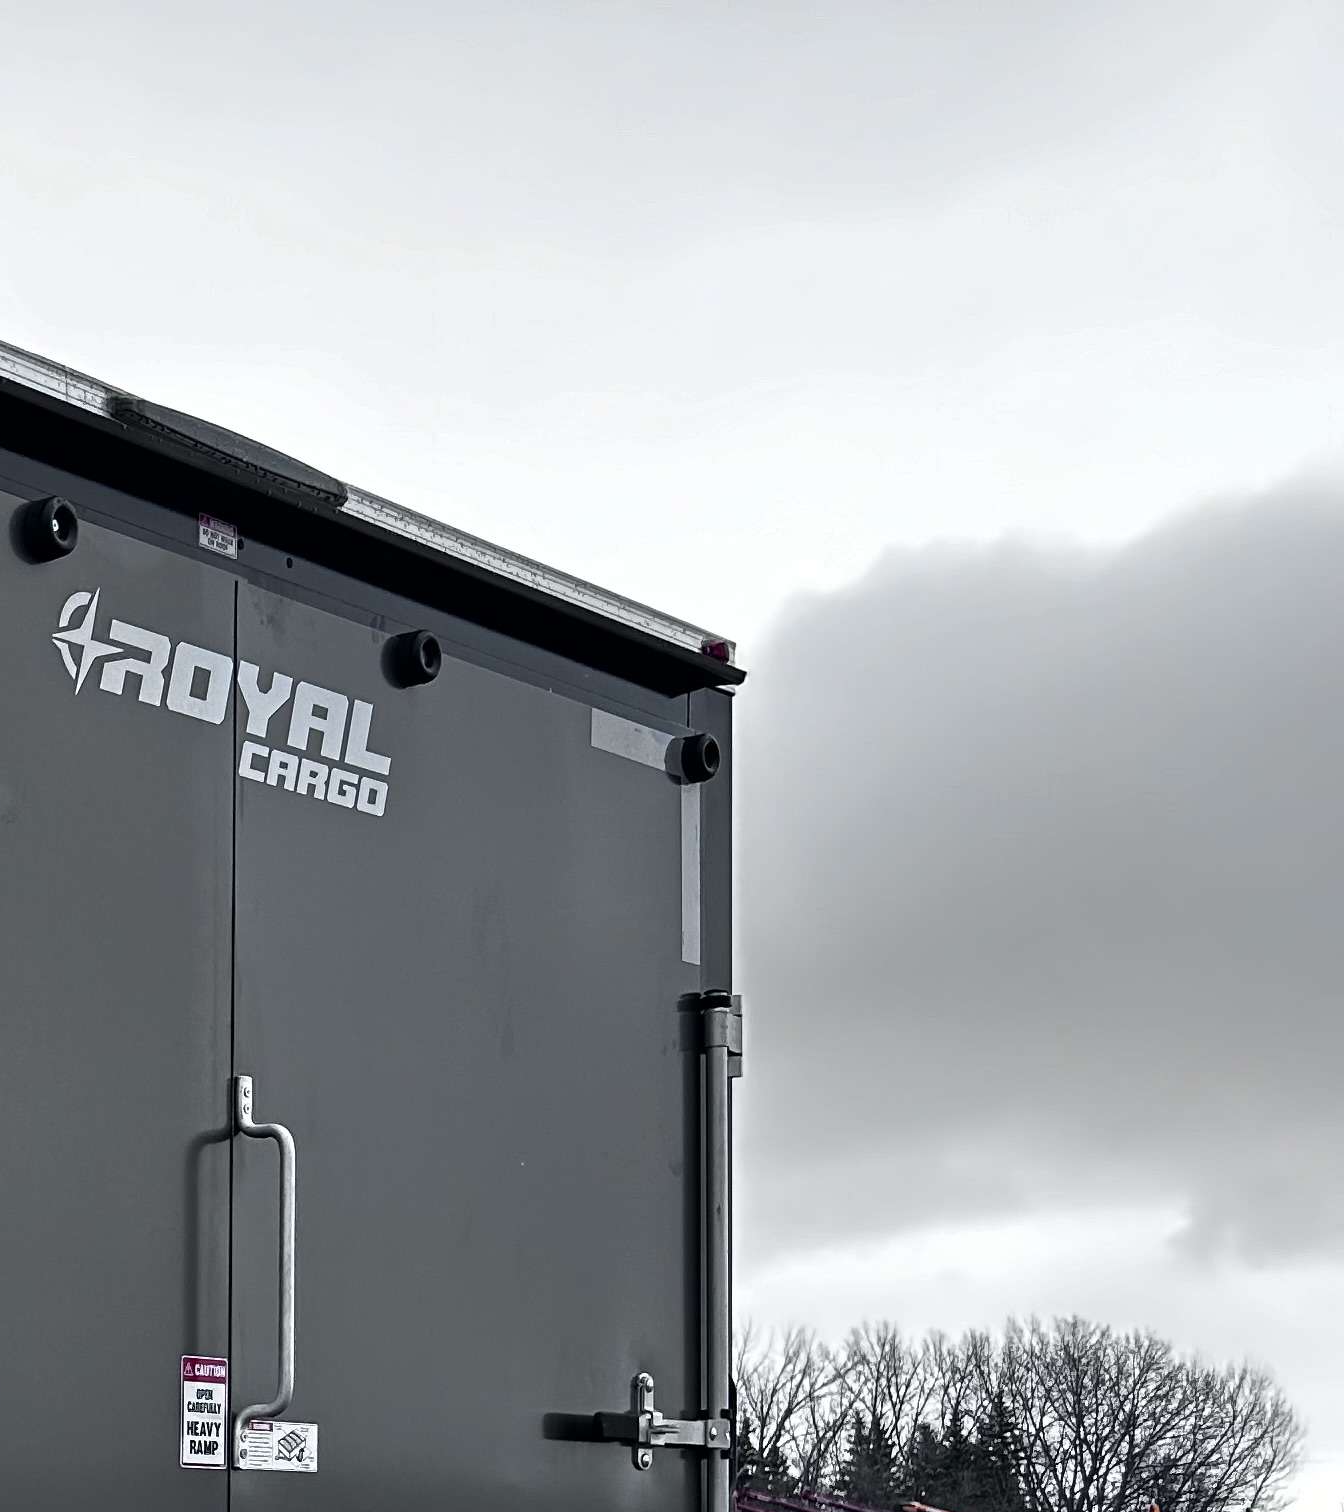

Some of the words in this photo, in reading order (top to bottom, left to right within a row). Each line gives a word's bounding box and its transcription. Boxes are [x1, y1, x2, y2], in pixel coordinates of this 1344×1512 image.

[100, 619, 392, 775] ROYAL
[238, 740, 389, 817] CARGO
[194, 1363, 226, 1378] CAUTION
[196, 1388, 213, 1401] OPEN
[187, 1401, 222, 1415] CAREFULLY
[186, 1420, 222, 1437] HEAVY
[189, 1439, 219, 1456] RAMP
